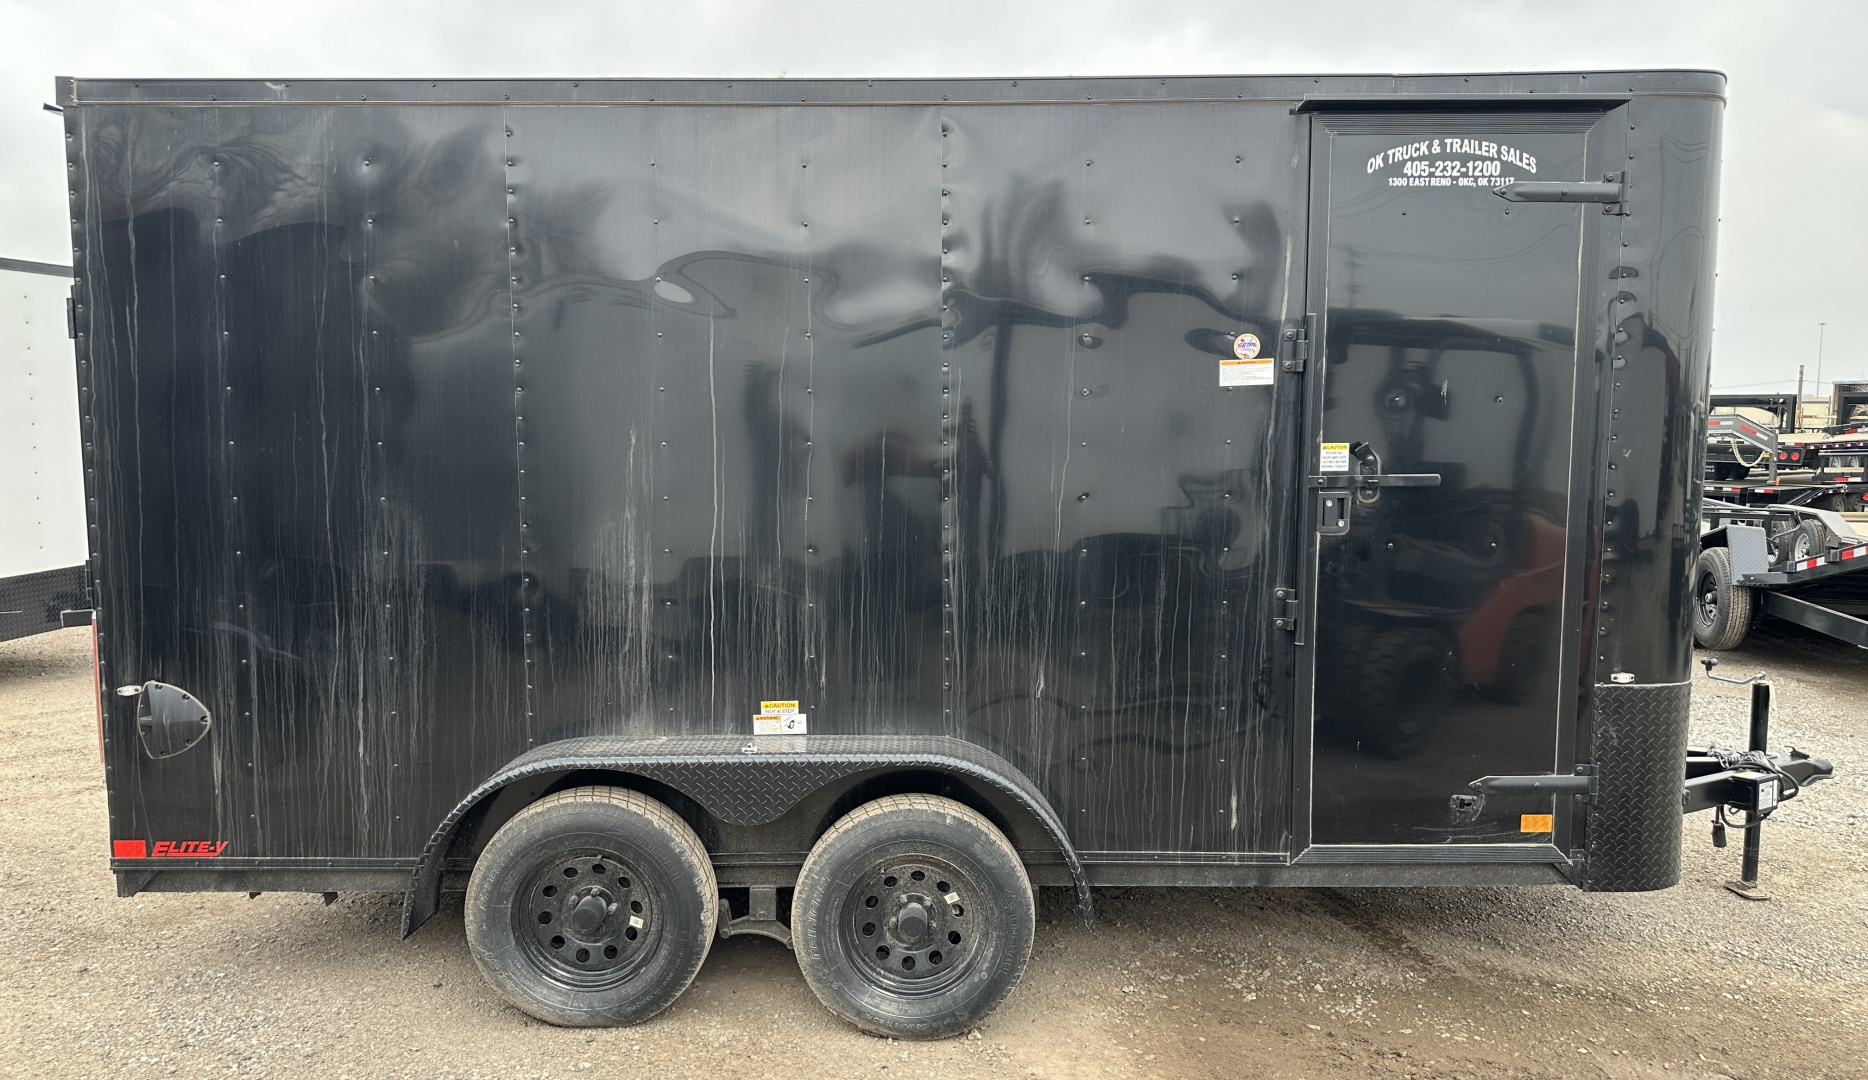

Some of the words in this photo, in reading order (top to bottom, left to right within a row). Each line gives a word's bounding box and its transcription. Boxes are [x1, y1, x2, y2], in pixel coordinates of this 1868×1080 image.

[1367, 152, 1385, 174] OK
[1387, 141, 1430, 165] TRUCK
[1431, 139, 1441, 154] &
[1444, 138, 1498, 158] TRAILER
[1500, 145, 1537, 174] SALES
[1403, 160, 1501, 177] 405-232-1200
[1388, 177, 1408, 187] 1300
[1409, 177, 1430, 187] EAST
[1431, 177, 1451, 187] RENO
[1458, 177, 1476, 188] OKC,
[1478, 177, 1489, 187] OK
[1490, 177, 1515, 187] 73117
[151, 841, 229, 857] ELITE-V
